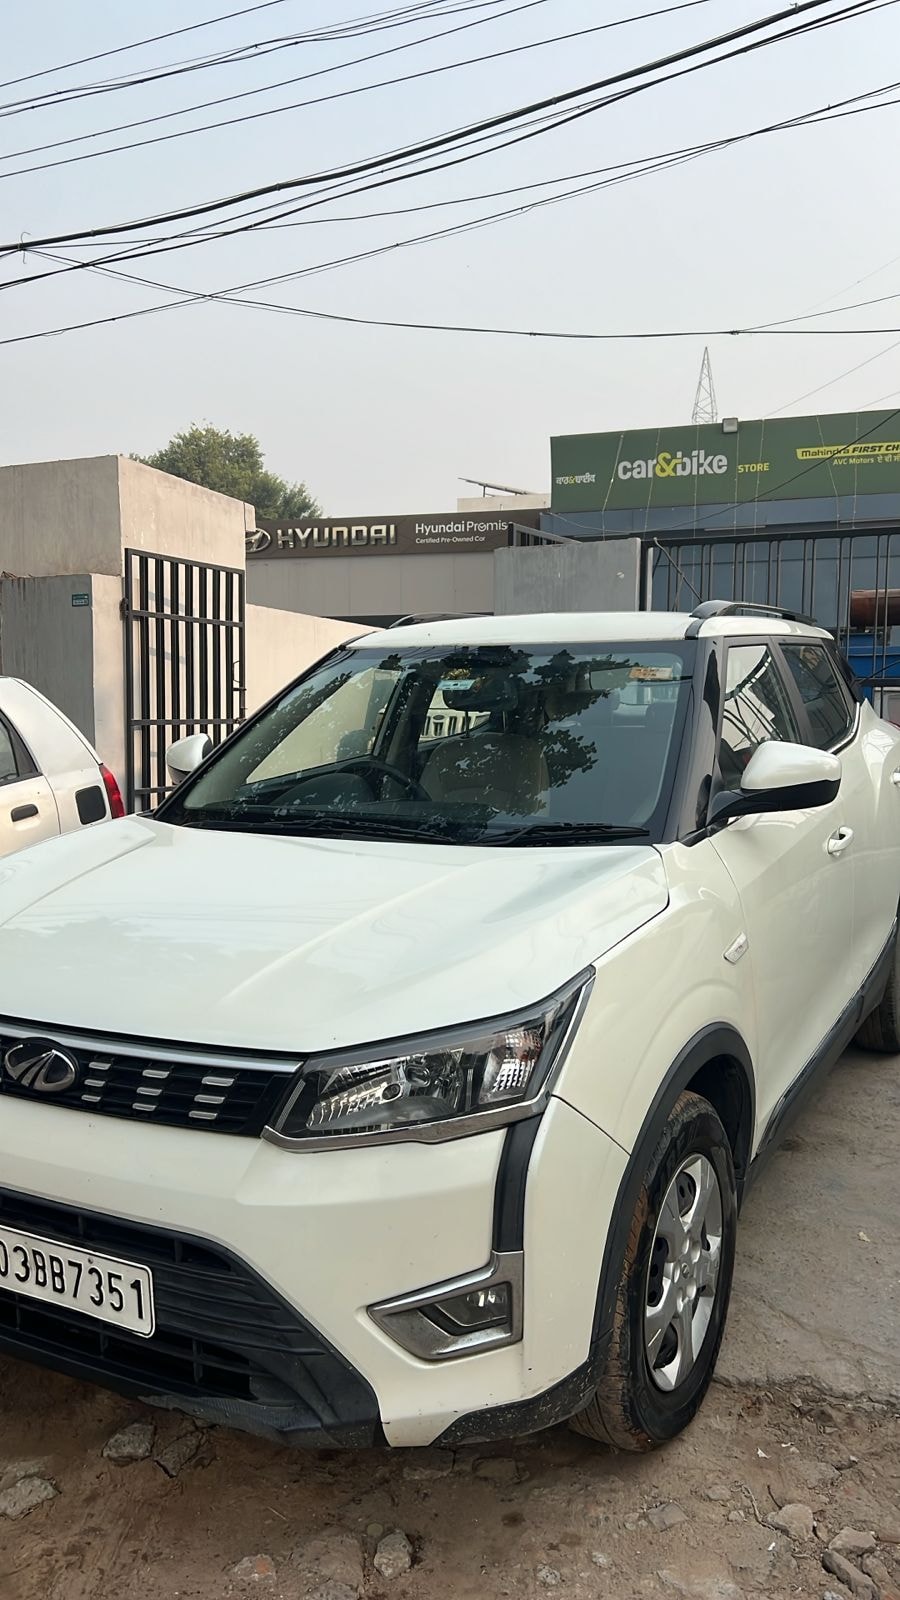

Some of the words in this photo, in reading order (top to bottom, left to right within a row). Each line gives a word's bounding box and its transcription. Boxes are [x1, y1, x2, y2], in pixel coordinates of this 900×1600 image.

[801, 447, 850, 458] Mahindra
[851, 444, 884, 454] FIRST
[617, 449, 728, 480] car&bike
[737, 462, 770, 474] STORE
[833, 458, 848, 466] AVC
[848, 456, 875, 465] Motors
[415, 521, 465, 535] Hyundai
[466, 520, 508, 532] Promis
[276, 524, 397, 548] HYUNDAI
[440, 535, 474, 543] Pre-Owned
